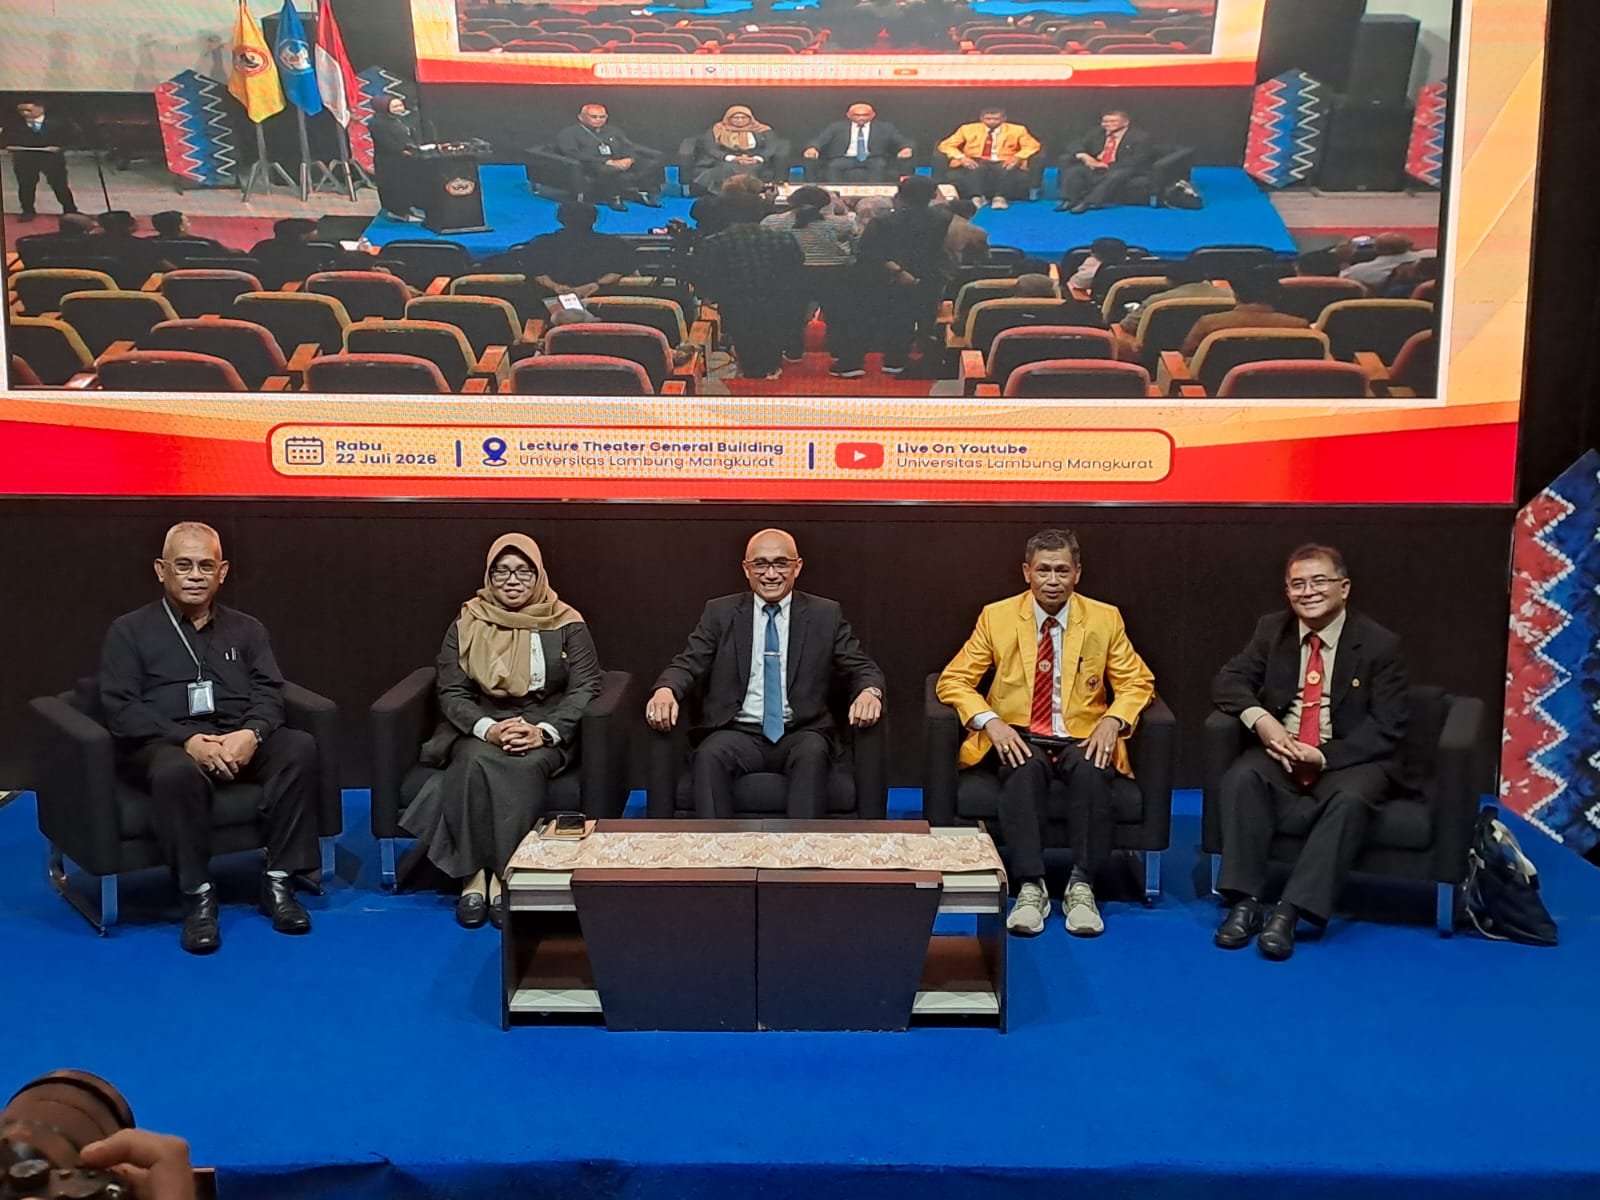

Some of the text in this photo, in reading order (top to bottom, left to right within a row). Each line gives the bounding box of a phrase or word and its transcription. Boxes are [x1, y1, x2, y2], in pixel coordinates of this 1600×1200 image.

[336, 440, 382, 451] Rabu
[519, 440, 784, 456] Lecture Theater General Building
[897, 442, 1028, 454] Live On Youtube
[335, 453, 437, 465] 22 Juli 2026
[519, 455, 775, 470] Universitas Lambung Mangkurat
[897, 457, 1154, 472] Universitas Lambung Mangkurat
